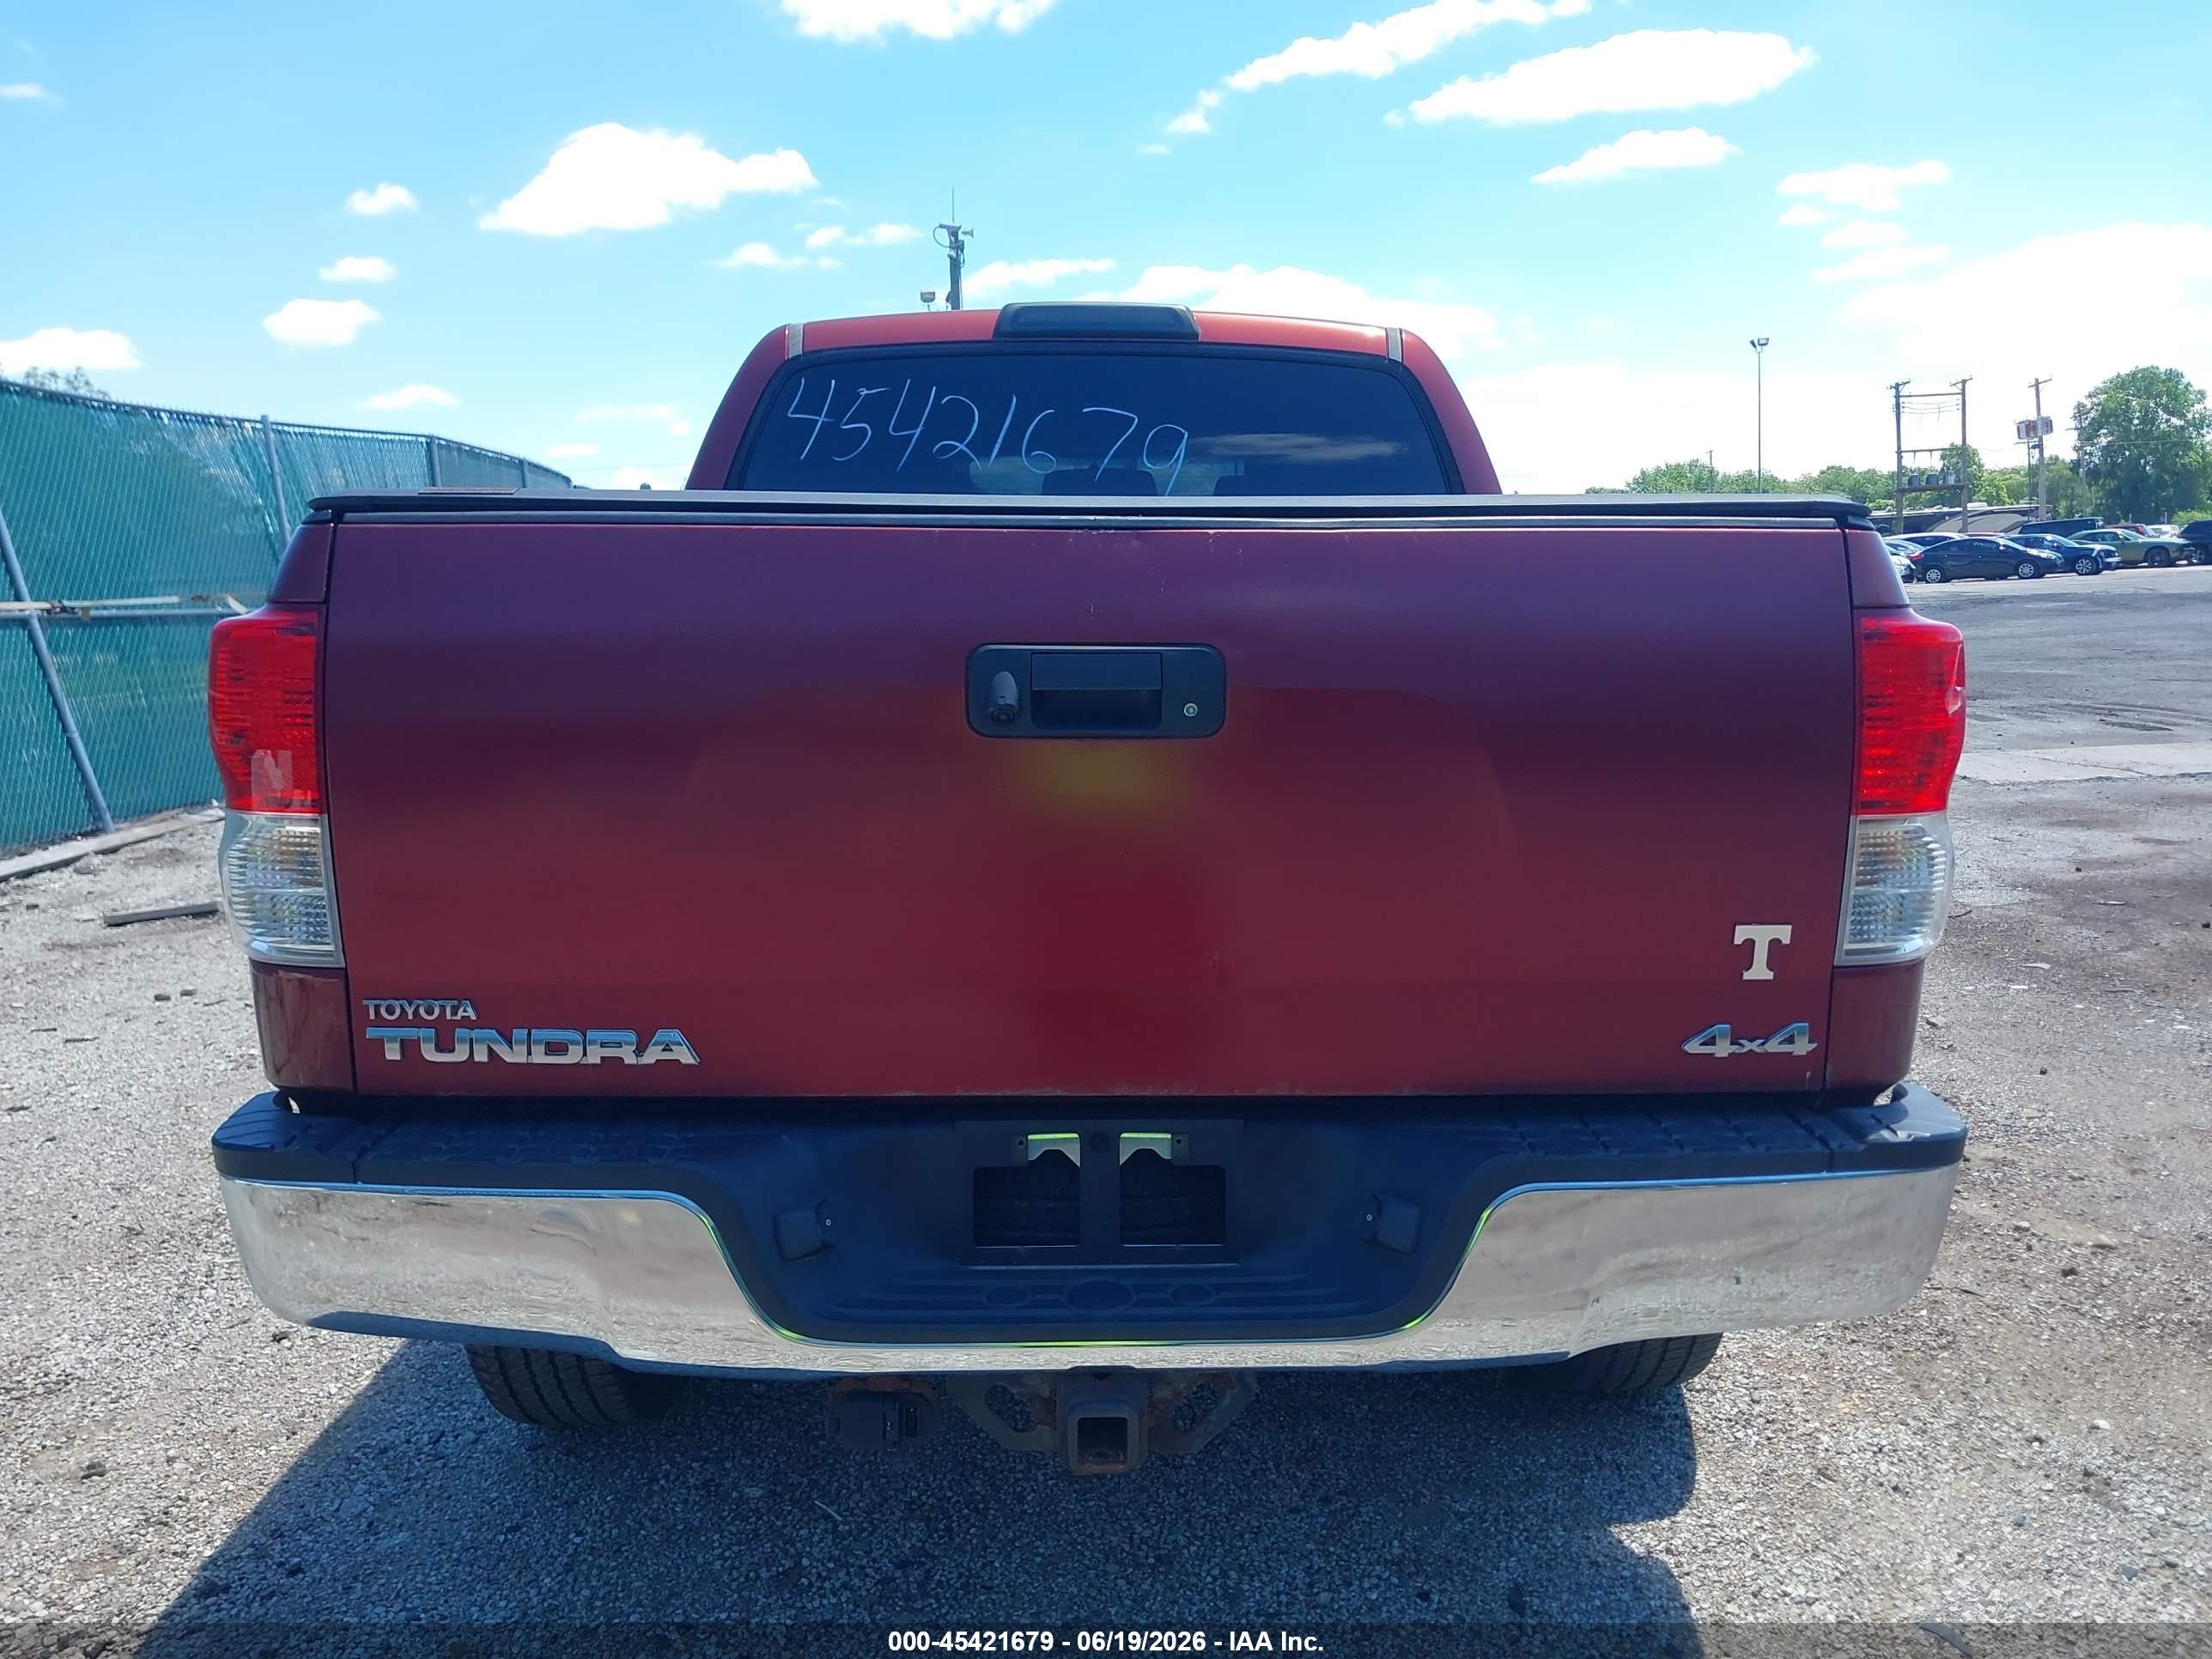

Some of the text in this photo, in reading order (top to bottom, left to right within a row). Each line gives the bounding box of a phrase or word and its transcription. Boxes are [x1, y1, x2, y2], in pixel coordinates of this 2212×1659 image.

[787, 377, 1188, 495] 45421679
[1733, 924, 1793, 981] T
[362, 1000, 477, 1021] TOYOTA
[366, 1026, 702, 1066] TUNDRA
[1681, 1022, 1819, 1058] 4x4
